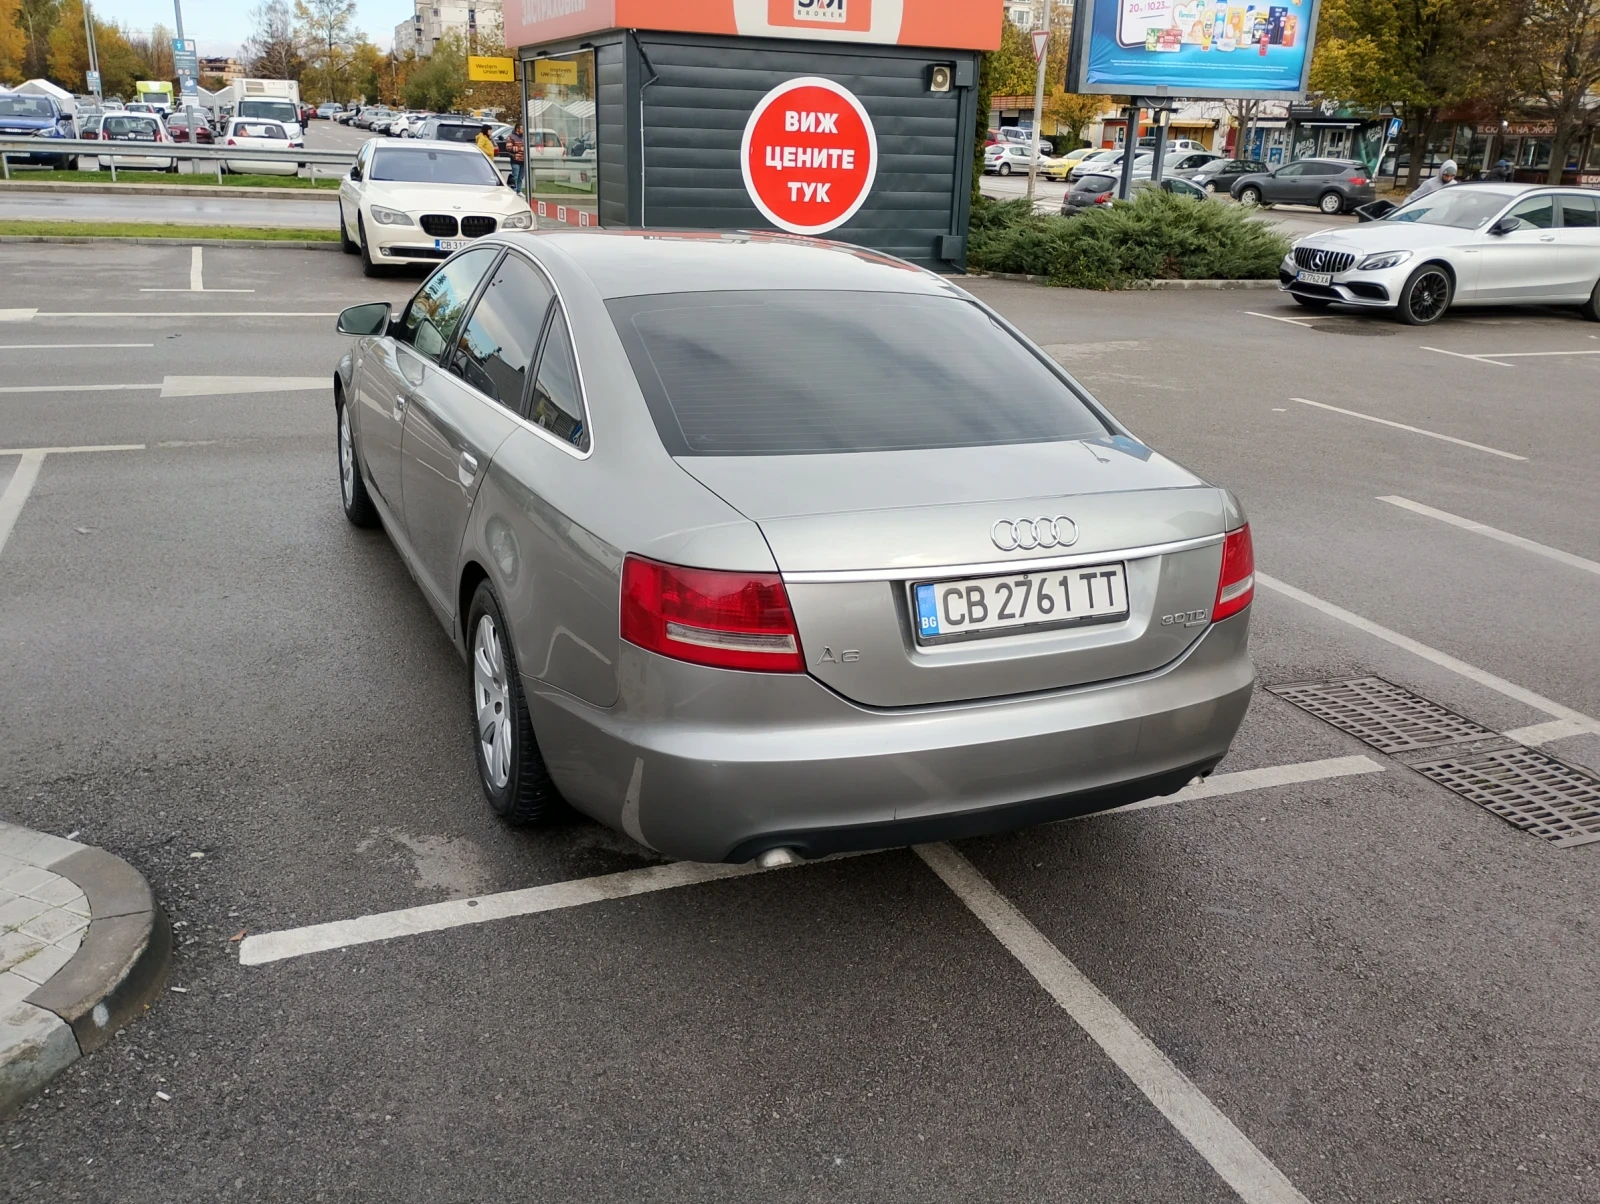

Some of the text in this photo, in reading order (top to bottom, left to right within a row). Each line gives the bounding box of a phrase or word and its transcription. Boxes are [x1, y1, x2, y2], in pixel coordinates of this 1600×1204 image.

[797, 10, 843, 18] BROKER
[785, 110, 839, 133] ВИЖ
[765, 146, 855, 170] ЦЕНИТЕ
[787, 182, 831, 203] ТУК
[943, 571, 1117, 625] CB 2761 TT
[921, 616, 937, 628] BG
[815, 645, 860, 665] A6
